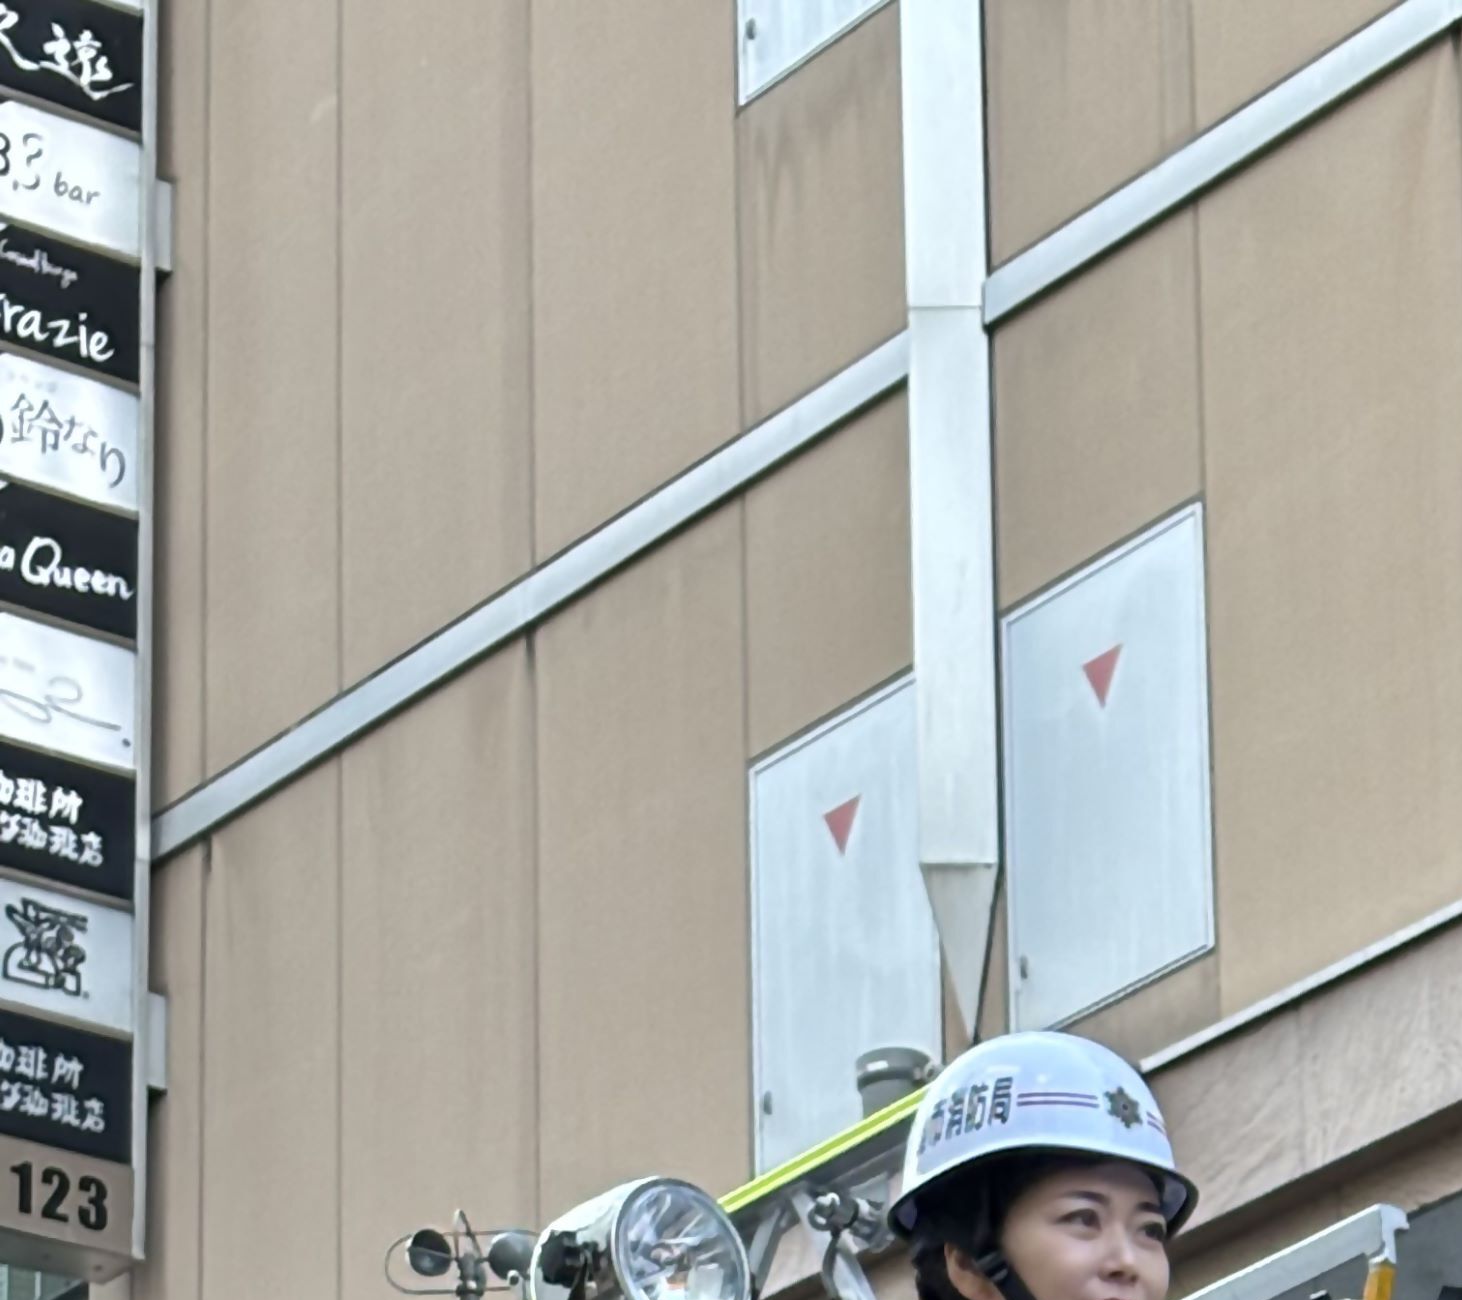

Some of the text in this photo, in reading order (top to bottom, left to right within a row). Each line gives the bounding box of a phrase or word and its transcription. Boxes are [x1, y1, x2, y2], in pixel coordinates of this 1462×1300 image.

[53, 171, 101, 205] bar
[0, 292, 115, 363] razie
[21, 537, 135, 600] Queen
[10, 1161, 108, 1231] 123
